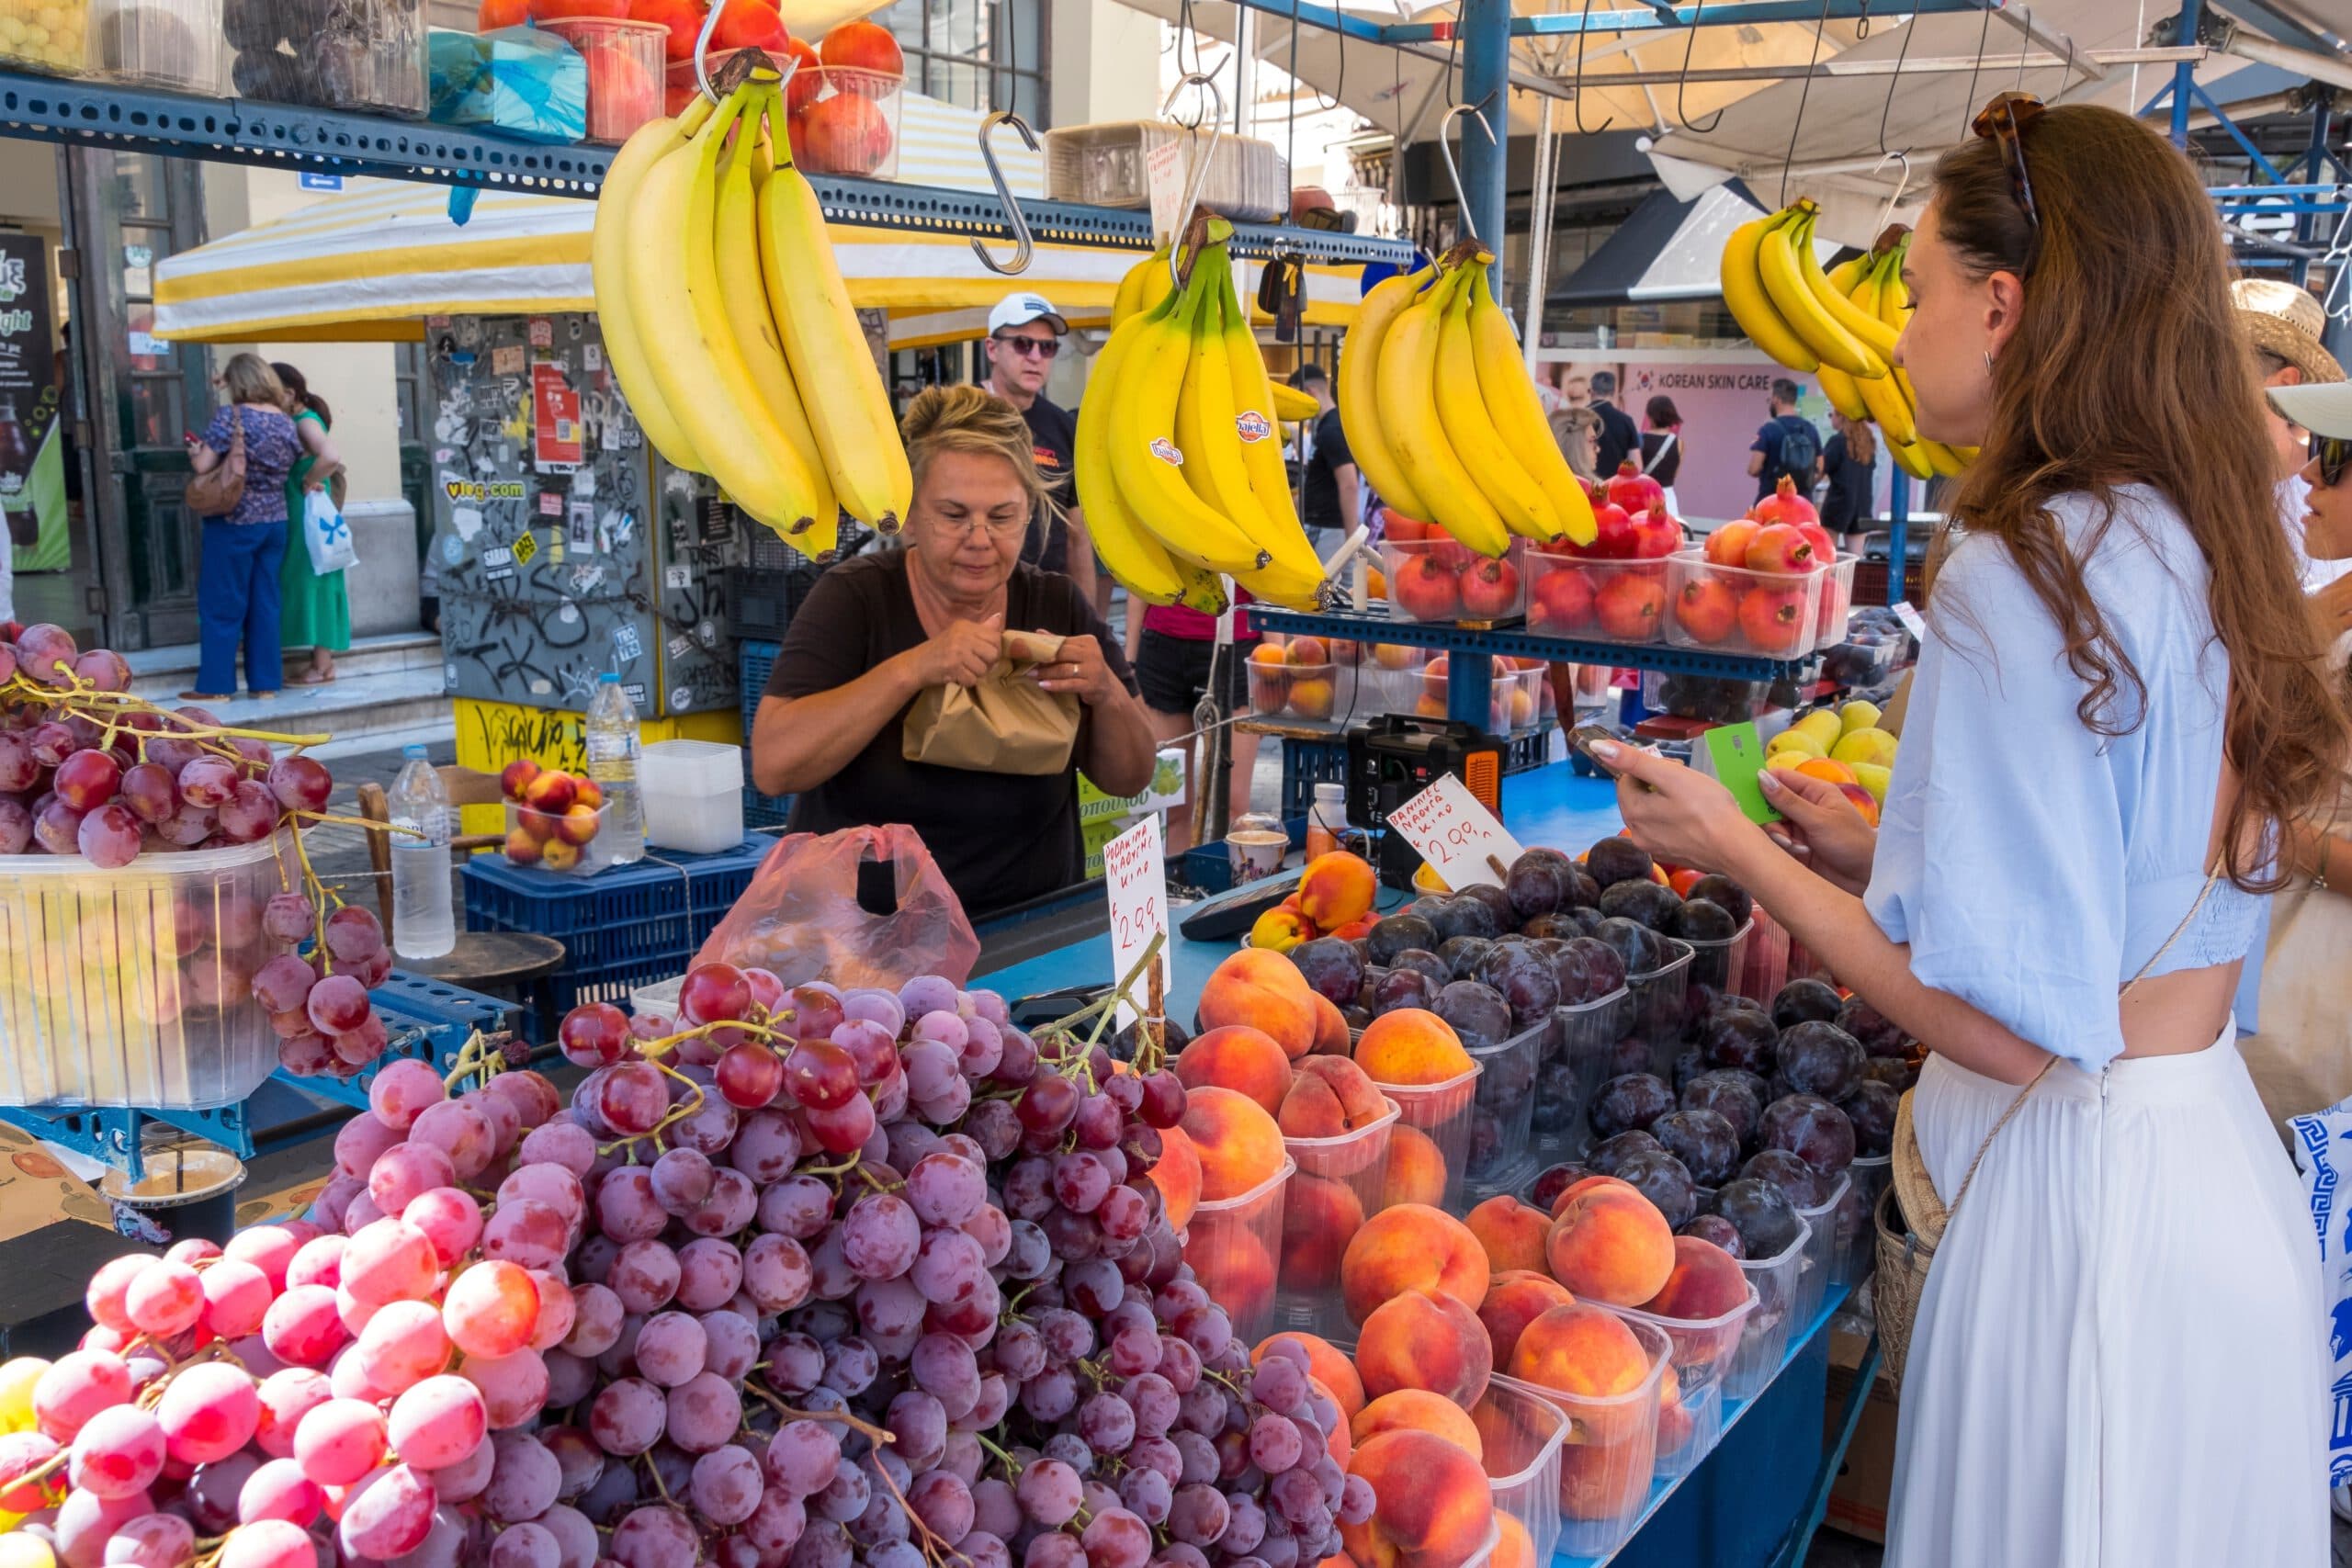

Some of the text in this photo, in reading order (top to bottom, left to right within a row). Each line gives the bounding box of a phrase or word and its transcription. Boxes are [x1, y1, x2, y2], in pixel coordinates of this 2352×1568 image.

[1659, 374, 1770, 389] KOREAN SKIN CARE
